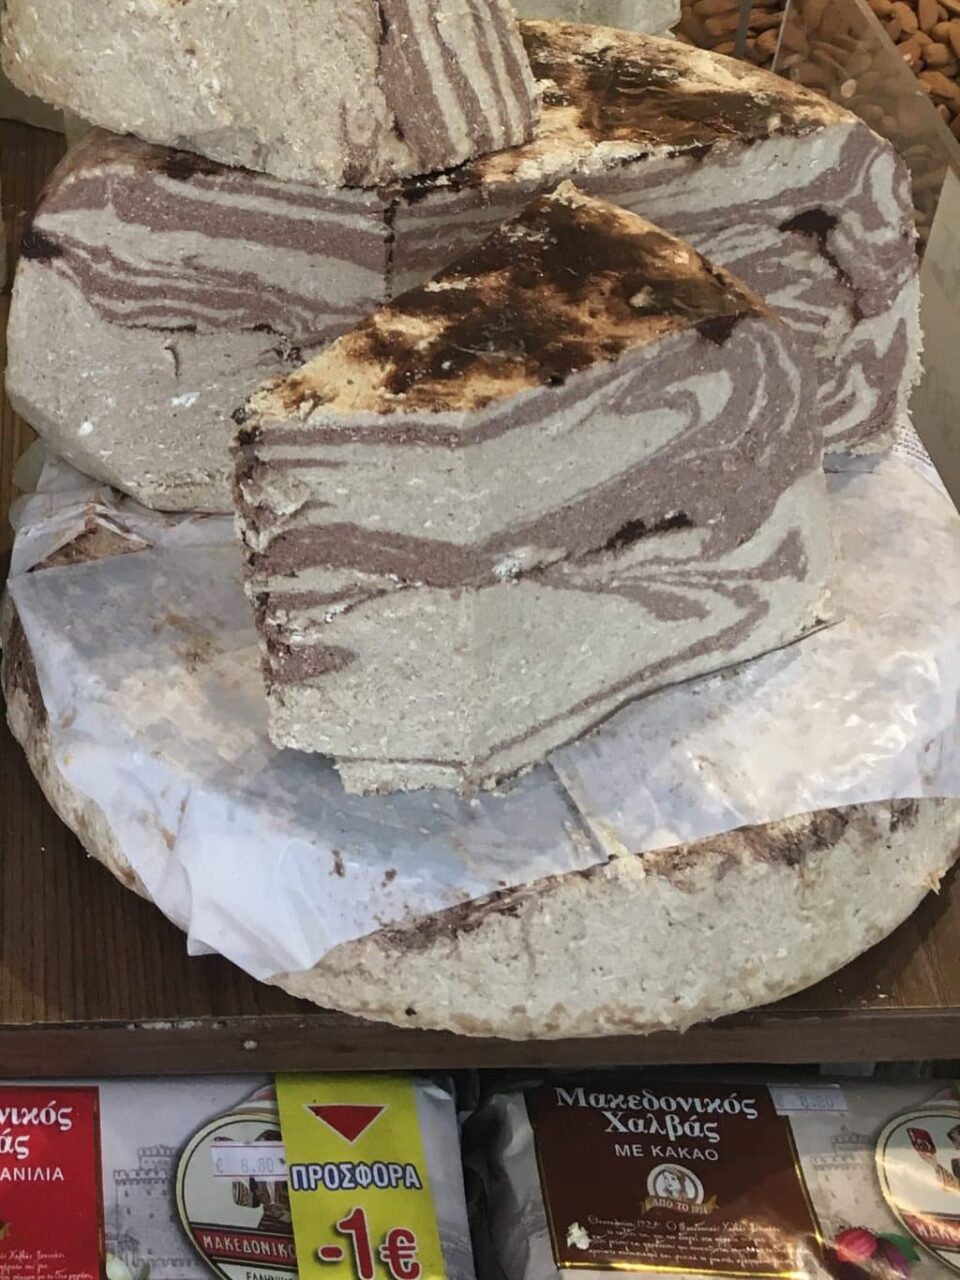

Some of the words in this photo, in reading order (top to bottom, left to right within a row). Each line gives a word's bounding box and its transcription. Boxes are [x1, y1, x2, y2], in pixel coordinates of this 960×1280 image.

[554, 1086, 759, 1119] Μακεδονικός
[601, 1109, 721, 1144] Χαλβάς
[614, 1143, 644, 1157] ΜΕ
[651, 1145, 720, 1162] ΚΑΚΑΟ
[291, 1162, 423, 1192] ΠΡΟΣΦΟΡΑ
